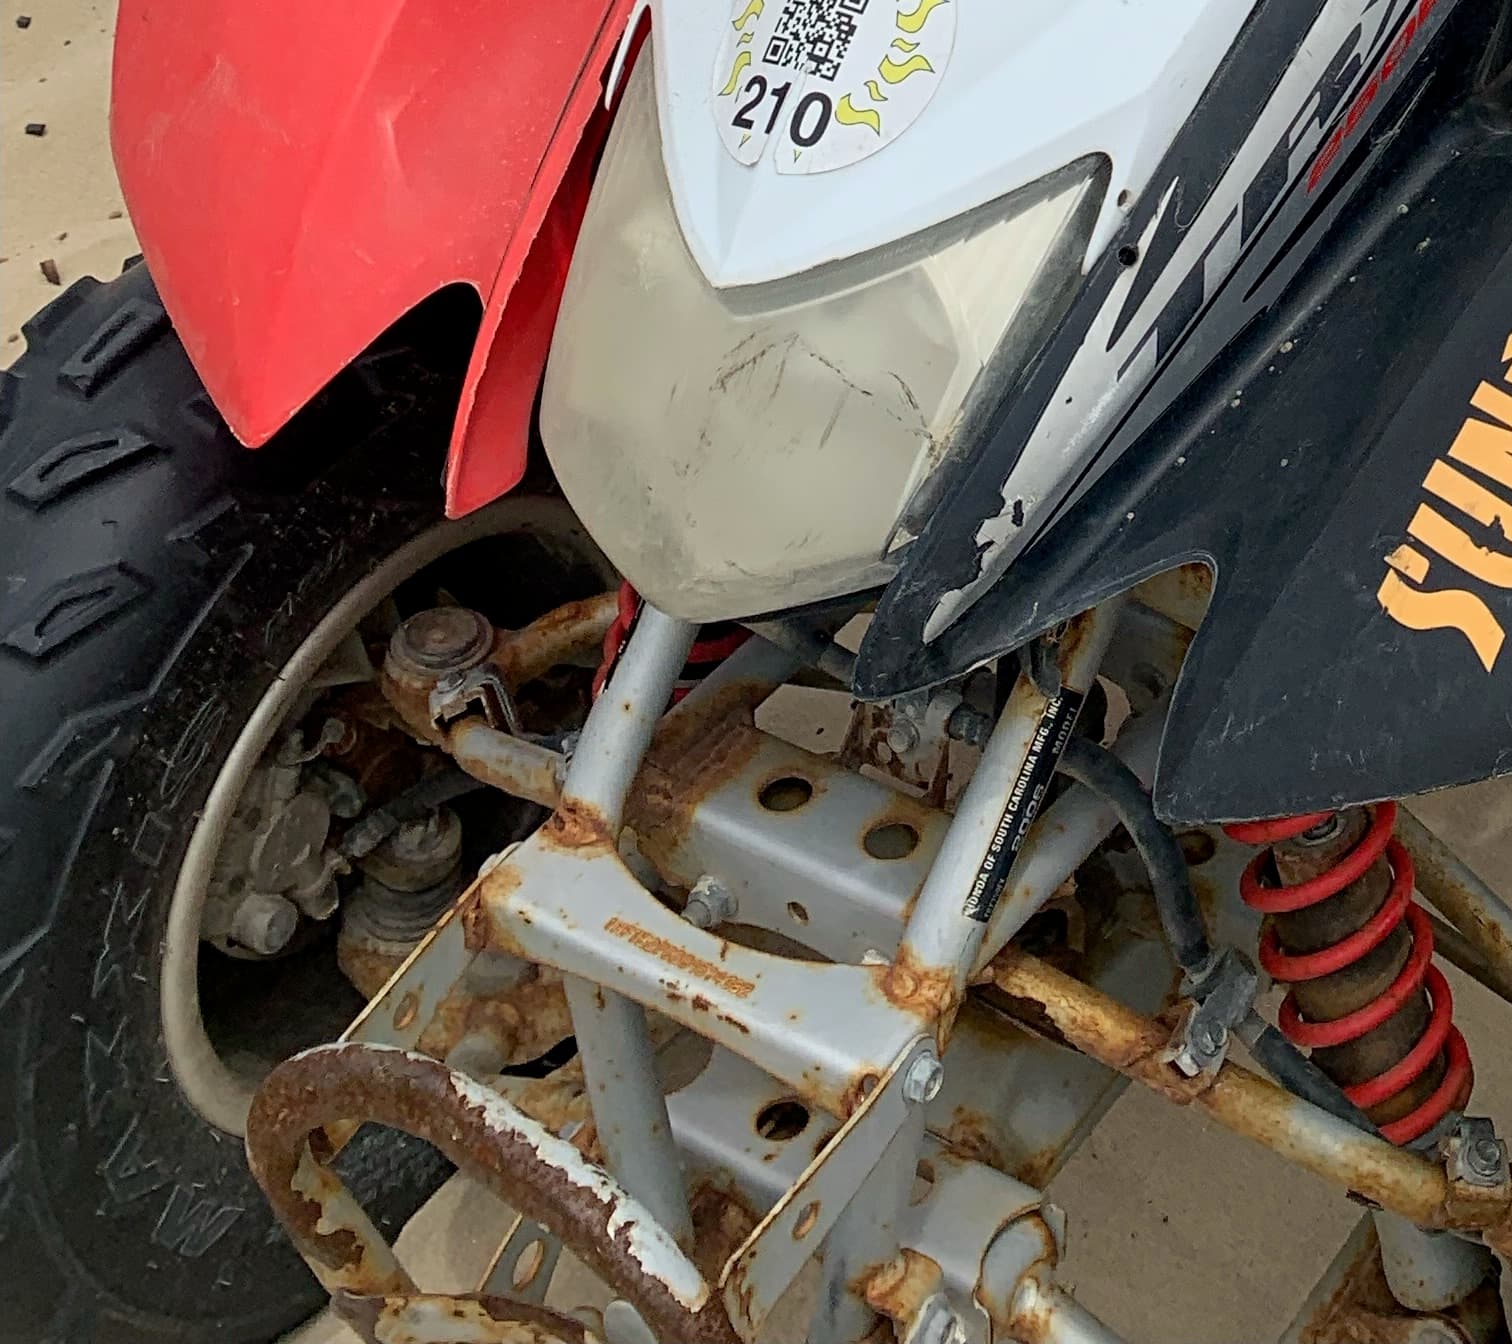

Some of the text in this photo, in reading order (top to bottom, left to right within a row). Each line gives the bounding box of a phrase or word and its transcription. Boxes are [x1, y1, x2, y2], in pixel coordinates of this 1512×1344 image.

[731, 75, 833, 147] 210
[1046, 694, 1064, 719] INC.
[1006, 753, 1039, 812] CAROLINA
[990, 812, 1014, 853] SOUTH
[984, 854, 997, 870] OF
